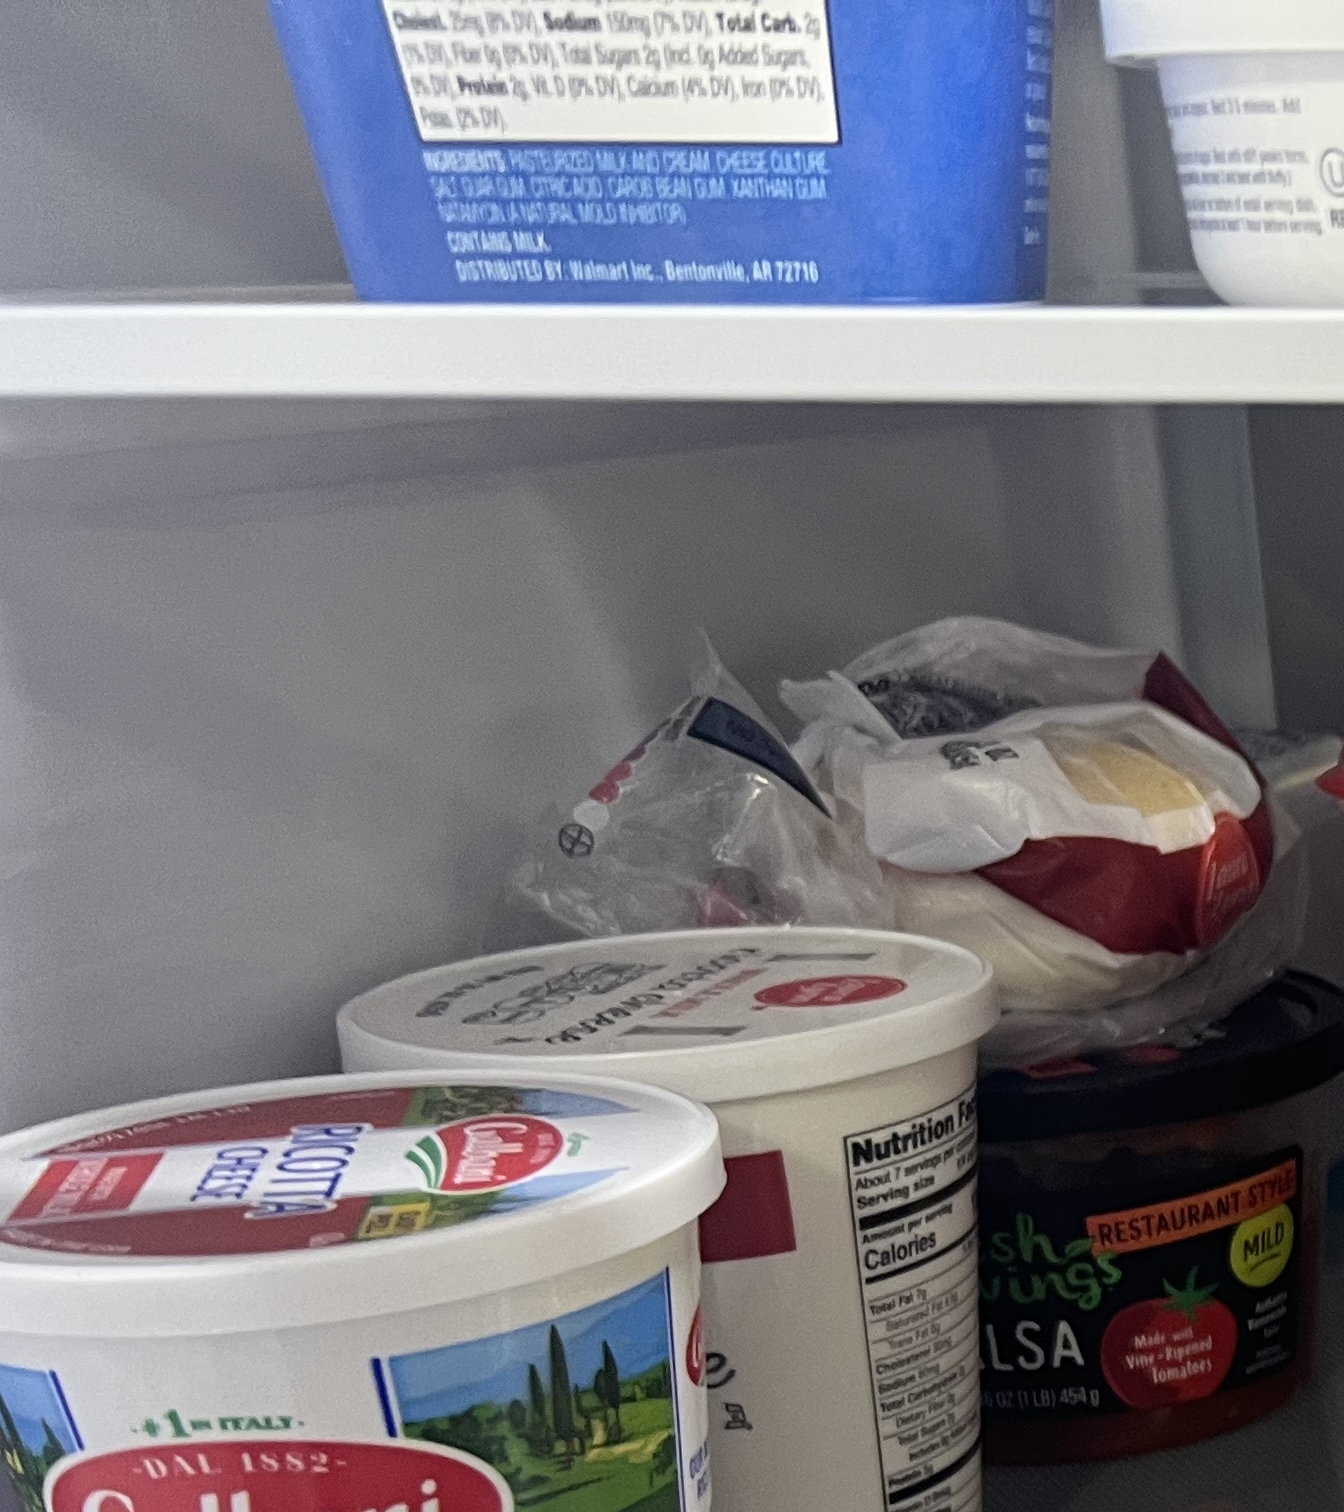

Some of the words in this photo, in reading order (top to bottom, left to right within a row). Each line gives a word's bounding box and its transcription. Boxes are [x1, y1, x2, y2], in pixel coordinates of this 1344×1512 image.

[715, 10, 756, 32] Total
[569, 259, 630, 283] Walmart
[664, 259, 750, 283] Bentonville,
[753, 259, 773, 283] AR
[774, 259, 819, 283] 72716
[852, 1114, 954, 1167] Nutrition
[190, 1146, 269, 1201] CHEESE
[252, 1124, 363, 1217] RICOTTA
[855, 1170, 891, 1191] About
[857, 1186, 910, 1210] Serving
[1098, 1192, 1242, 1247] RESTAURANT
[1248, 1167, 1294, 1209] STYLE
[864, 1232, 937, 1270] Calories
[1242, 1221, 1286, 1262] MILD
[981, 1318, 1086, 1371] LSA
[1134, 1330, 1166, 1349] Made
[1152, 1357, 1213, 1386] Tomatoes
[218, 1415, 293, 1431] ITALY
[241, 1452, 330, 1475] 1882
